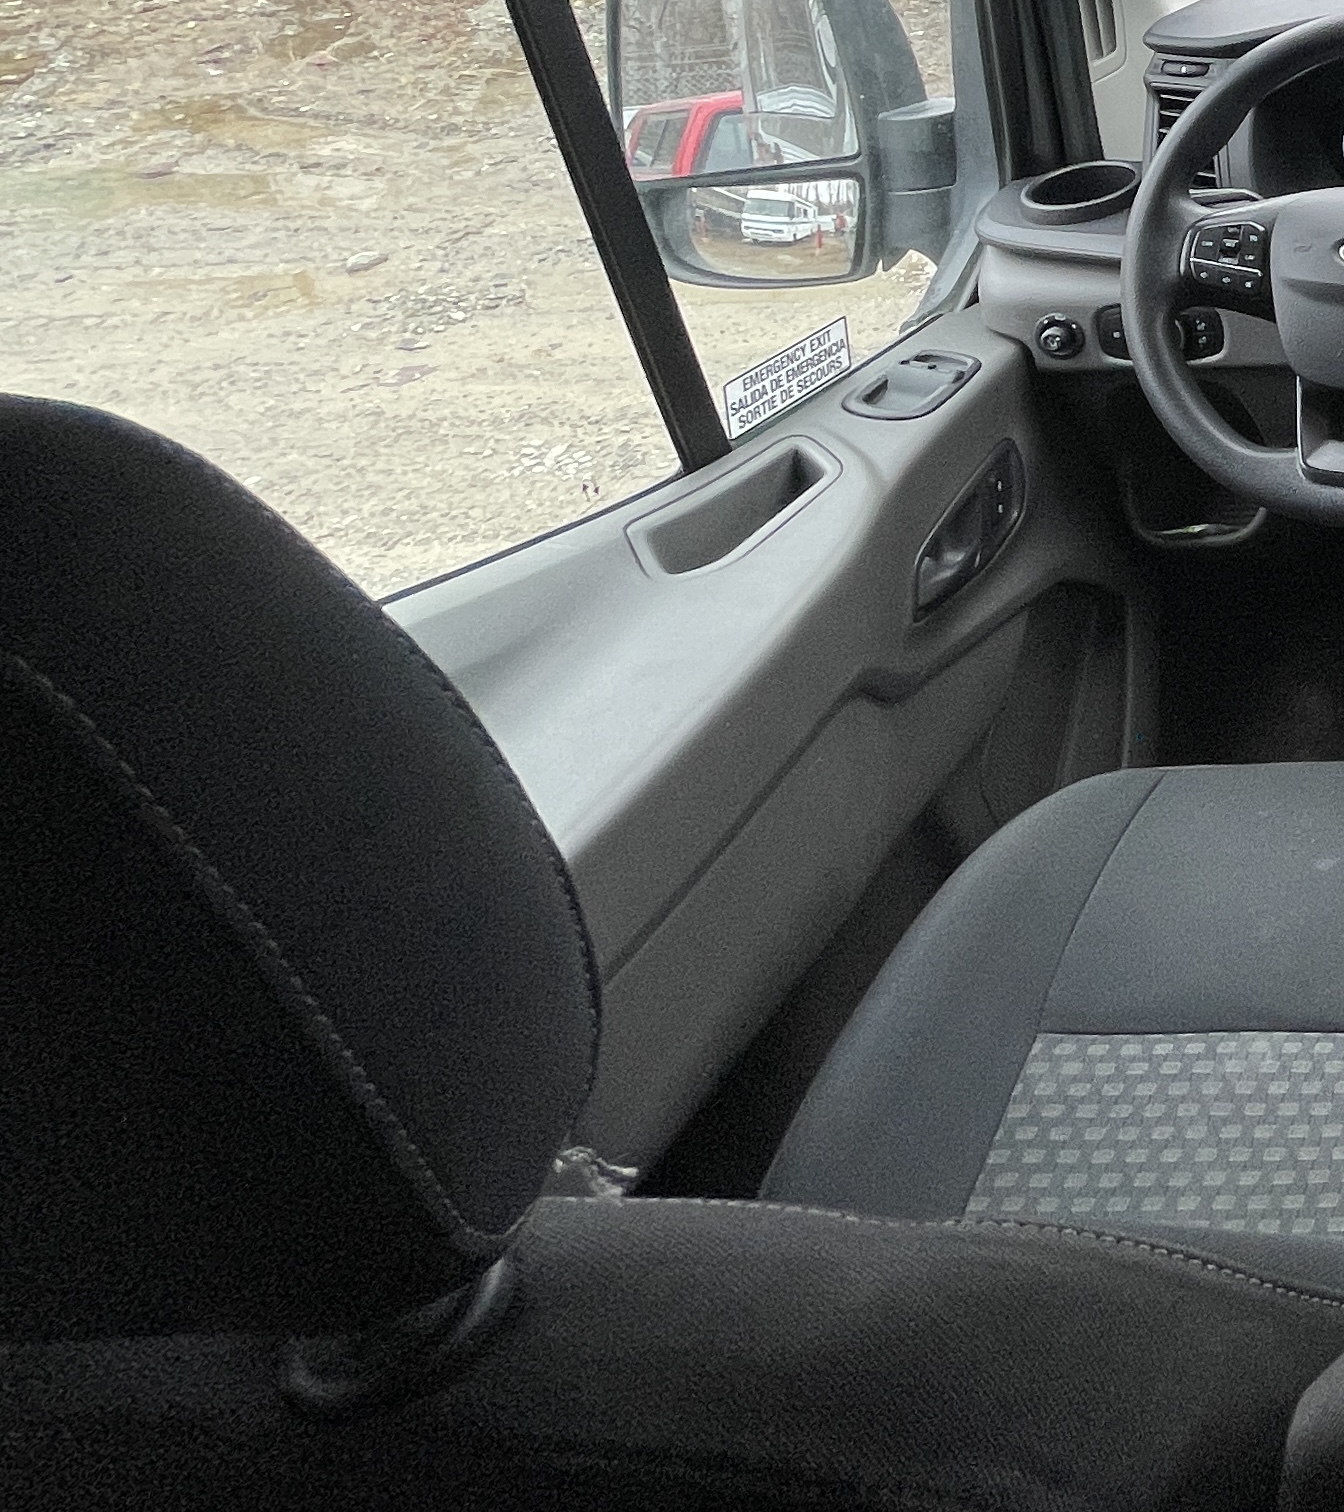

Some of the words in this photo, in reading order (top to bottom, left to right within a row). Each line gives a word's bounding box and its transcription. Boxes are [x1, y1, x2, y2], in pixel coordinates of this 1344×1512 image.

[730, 383, 768, 417] SALIDA
[770, 374, 784, 394] DE
[786, 338, 846, 384] EMERGENCIA
[738, 394, 778, 429] SORTIE
[780, 385, 794, 404] DE
[797, 356, 843, 394] SECOURS
[742, 345, 807, 392] EMERGENCY
[810, 328, 832, 354] EXIT
